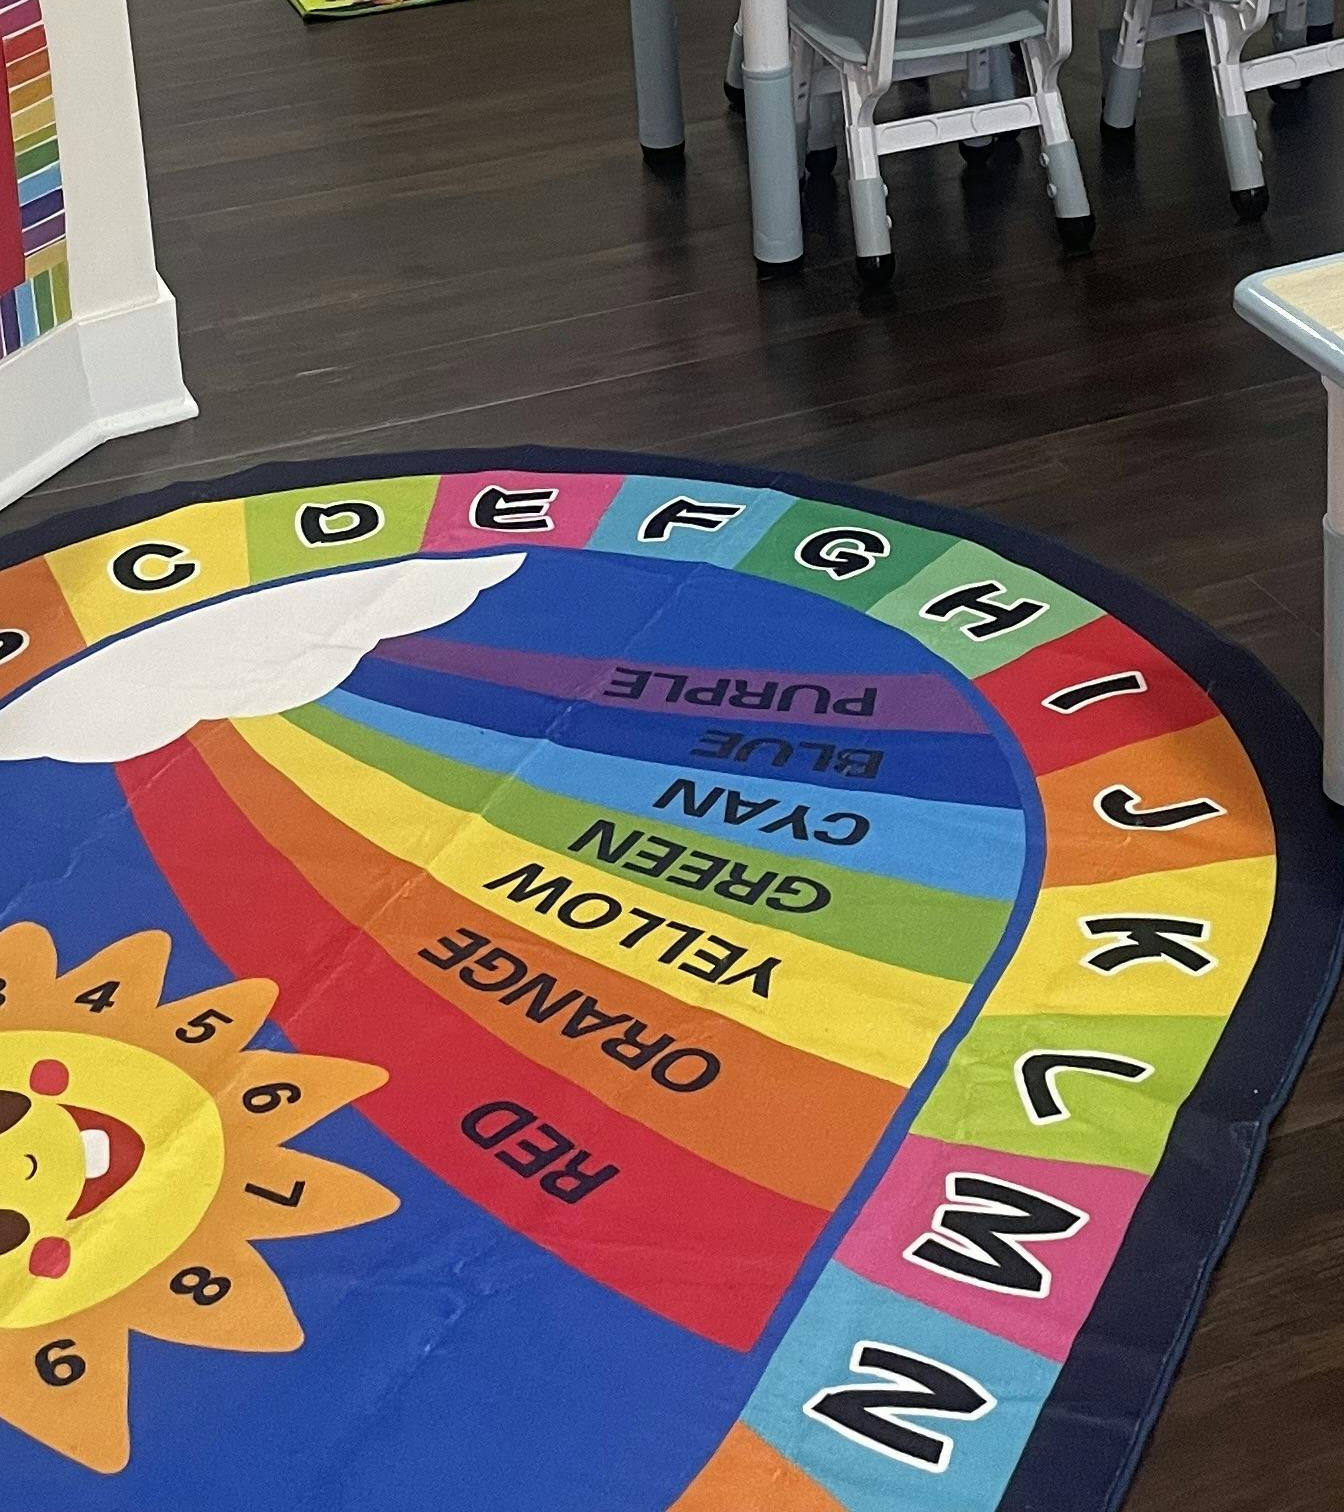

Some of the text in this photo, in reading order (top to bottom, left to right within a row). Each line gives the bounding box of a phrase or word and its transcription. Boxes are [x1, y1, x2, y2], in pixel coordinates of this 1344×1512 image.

[296, 498, 383, 549] D
[470, 483, 558, 534] E
[639, 495, 745, 544] F
[108, 539, 200, 595] C
[796, 525, 889, 581] G
[921, 579, 1048, 642] H
[602, 665, 878, 717] PURPLE
[1044, 670, 1145, 714] I
[690, 729, 884, 780] BLUE
[652, 778, 871, 846] CYAN
[1096, 785, 1224, 832] J
[567, 819, 832, 914] GREEN
[482, 863, 783, 999] YELLOW
[1081, 913, 1215, 976] K
[73, 980, 121, 1014] 4
[417, 927, 722, 1093] ORANGE
[174, 1007, 235, 1045] 5
[241, 1081, 303, 1115] 6
[1017, 1049, 1150, 1123] L
[460, 1100, 621, 1205] RED
[243, 1180, 307, 1209] 7
[908, 1173, 1085, 1296] M
[168, 1265, 233, 1307] 8
[33, 1338, 87, 1388] 9
[807, 1343, 991, 1468] N
